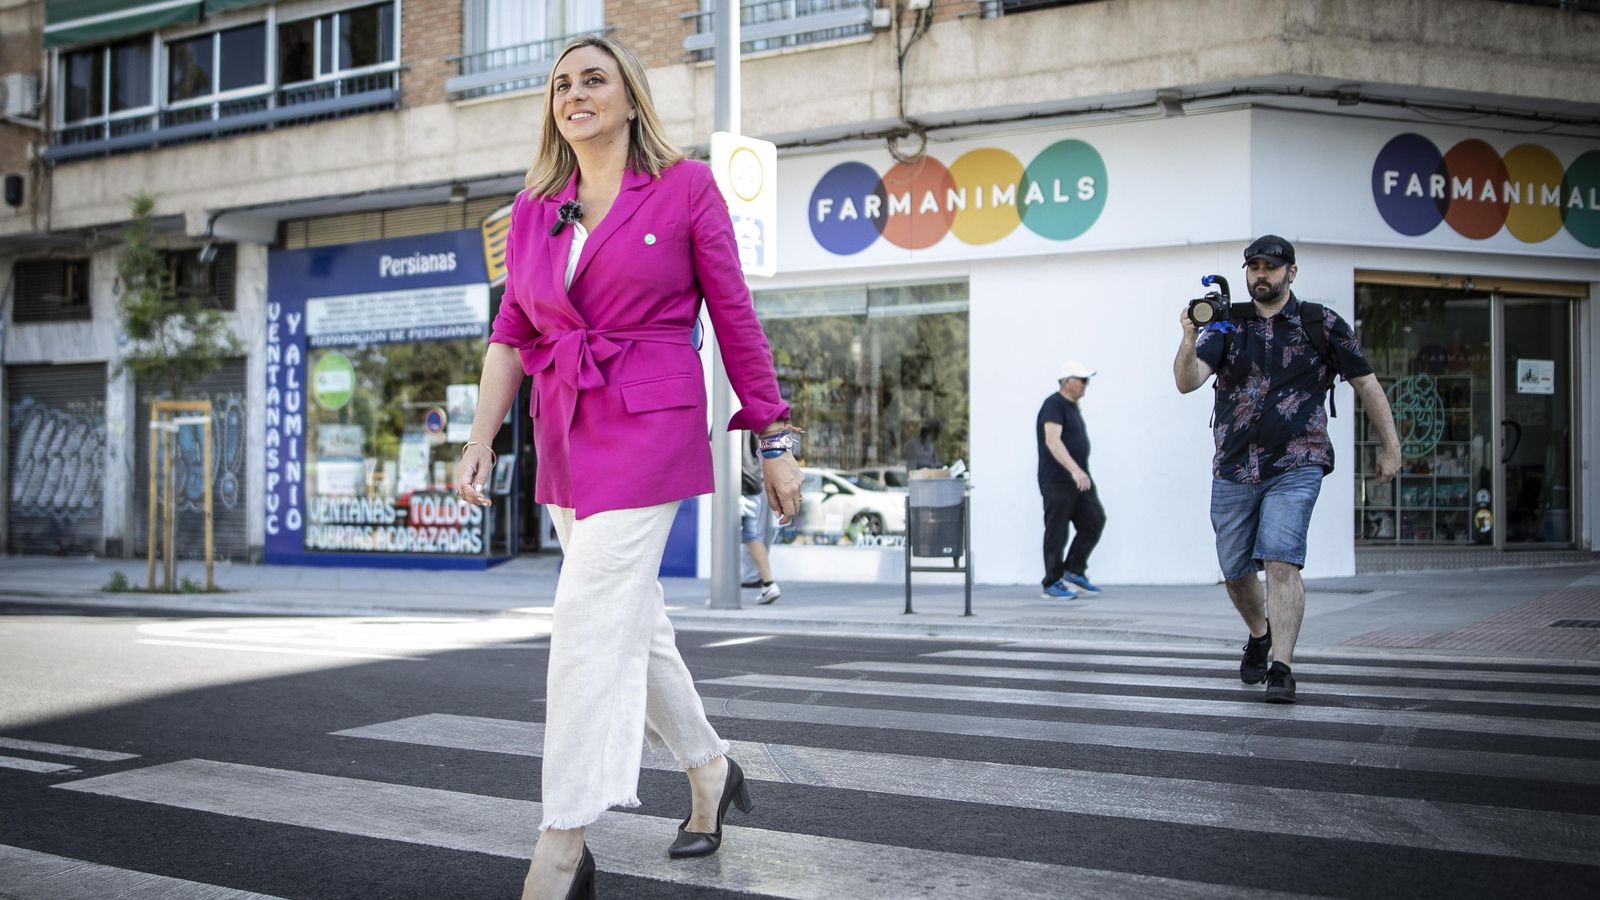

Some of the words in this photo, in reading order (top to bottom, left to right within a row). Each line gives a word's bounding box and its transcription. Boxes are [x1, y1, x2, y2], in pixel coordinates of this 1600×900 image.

[816, 175, 1096, 223] FARMANIMALS
[1383, 170, 1600, 210] FARMANIMAL
[379, 252, 457, 278] Persianas
[390, 328, 405, 341] DE
[409, 324, 482, 340] PERSIANAS
[284, 342, 302, 530] ALUMINIO
[410, 495, 482, 525] TOLDOS
[306, 526, 373, 551] PUERTAS
[374, 527, 482, 554] ACORAZADAS
